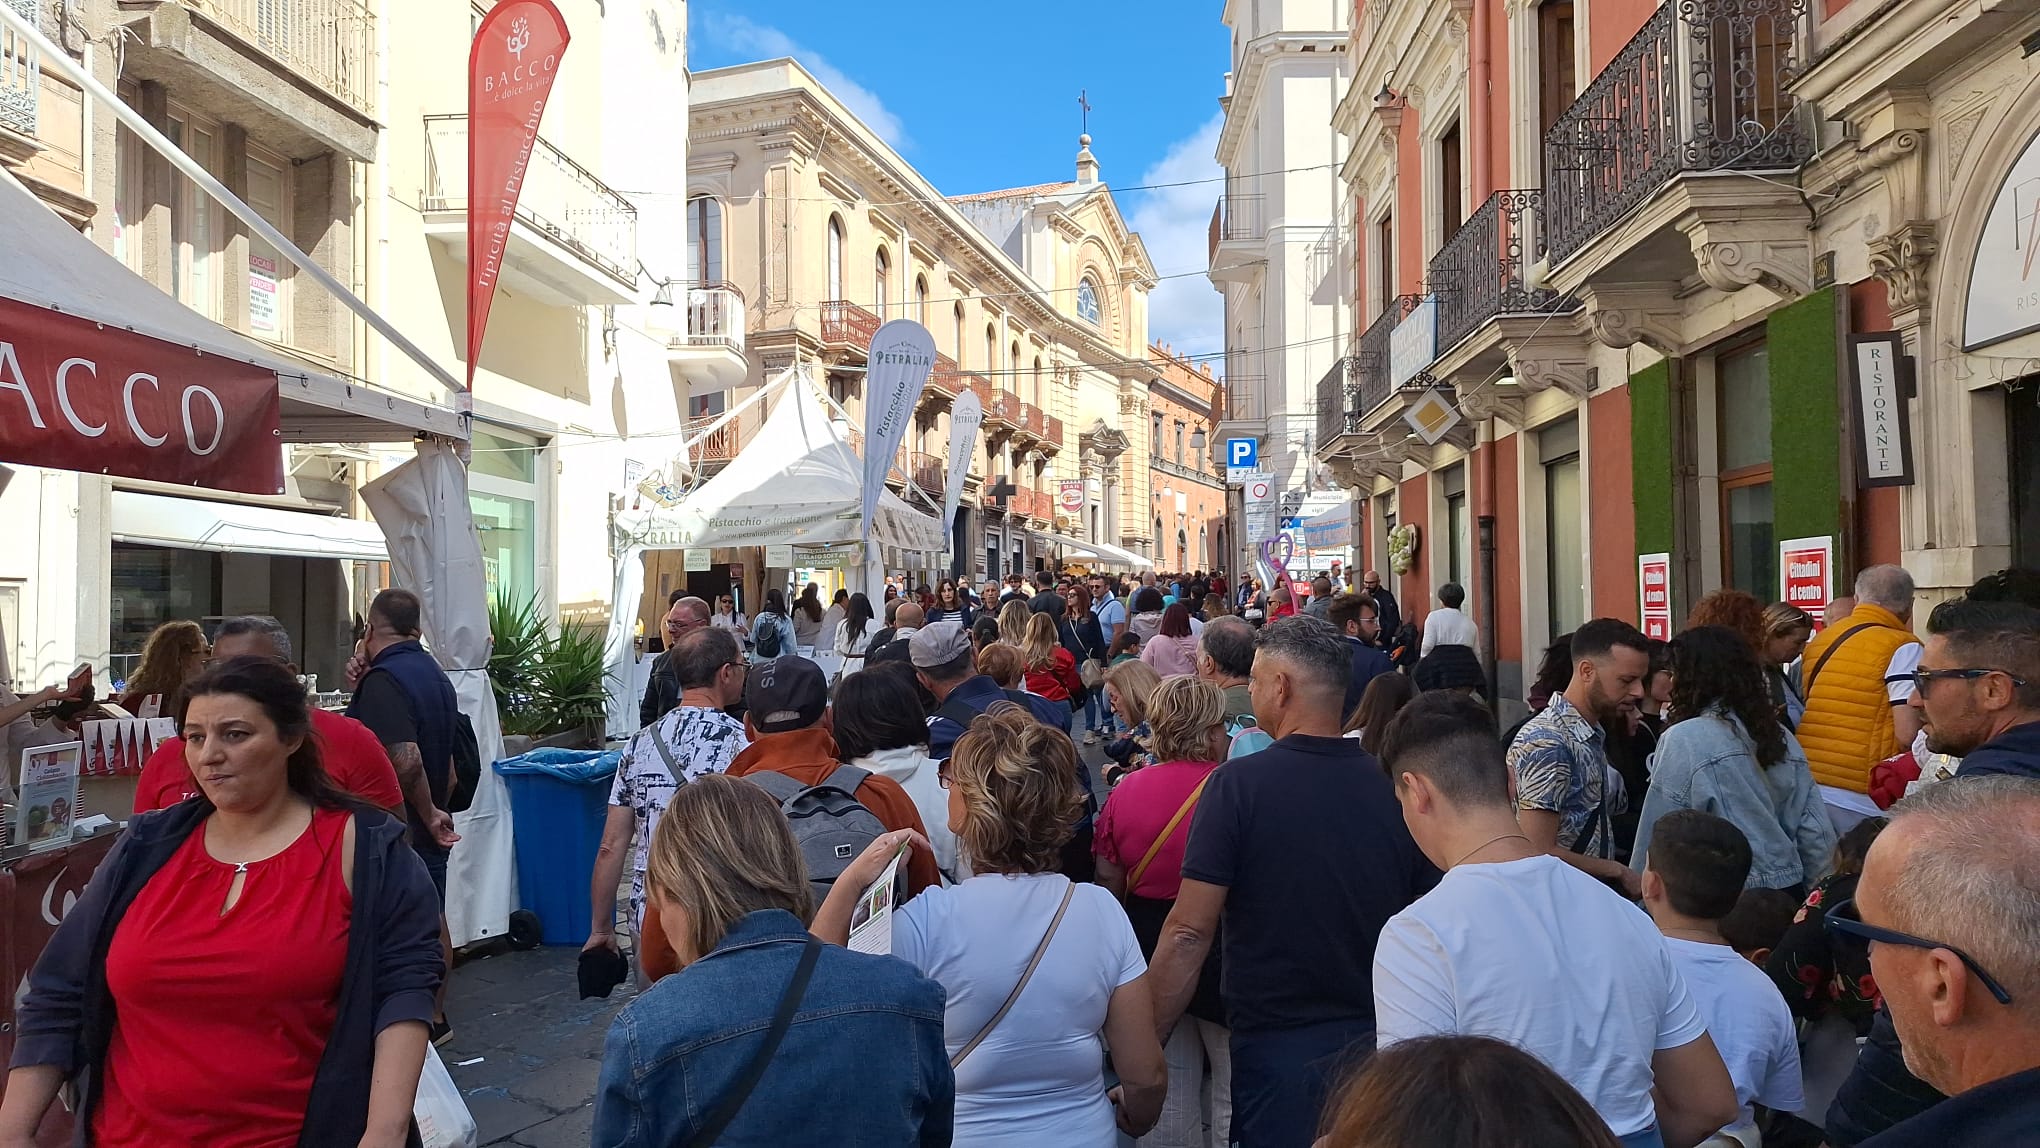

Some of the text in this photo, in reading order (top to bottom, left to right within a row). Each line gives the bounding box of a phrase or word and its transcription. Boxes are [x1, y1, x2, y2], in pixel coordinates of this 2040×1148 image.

[485, 54, 555, 92] BACCO
[479, 100, 543, 287] Tipicità al Pistacchio
[875, 351, 929, 367] PETRALIA
[876, 381, 906, 438] Pistacchio
[1871, 348, 1889, 472] RISTORANTE
[1233, 442, 1251, 464] P
[708, 516, 762, 527] Pistacchio
[773, 514, 822, 526] tradizione
[1790, 584, 1822, 600] al centro
